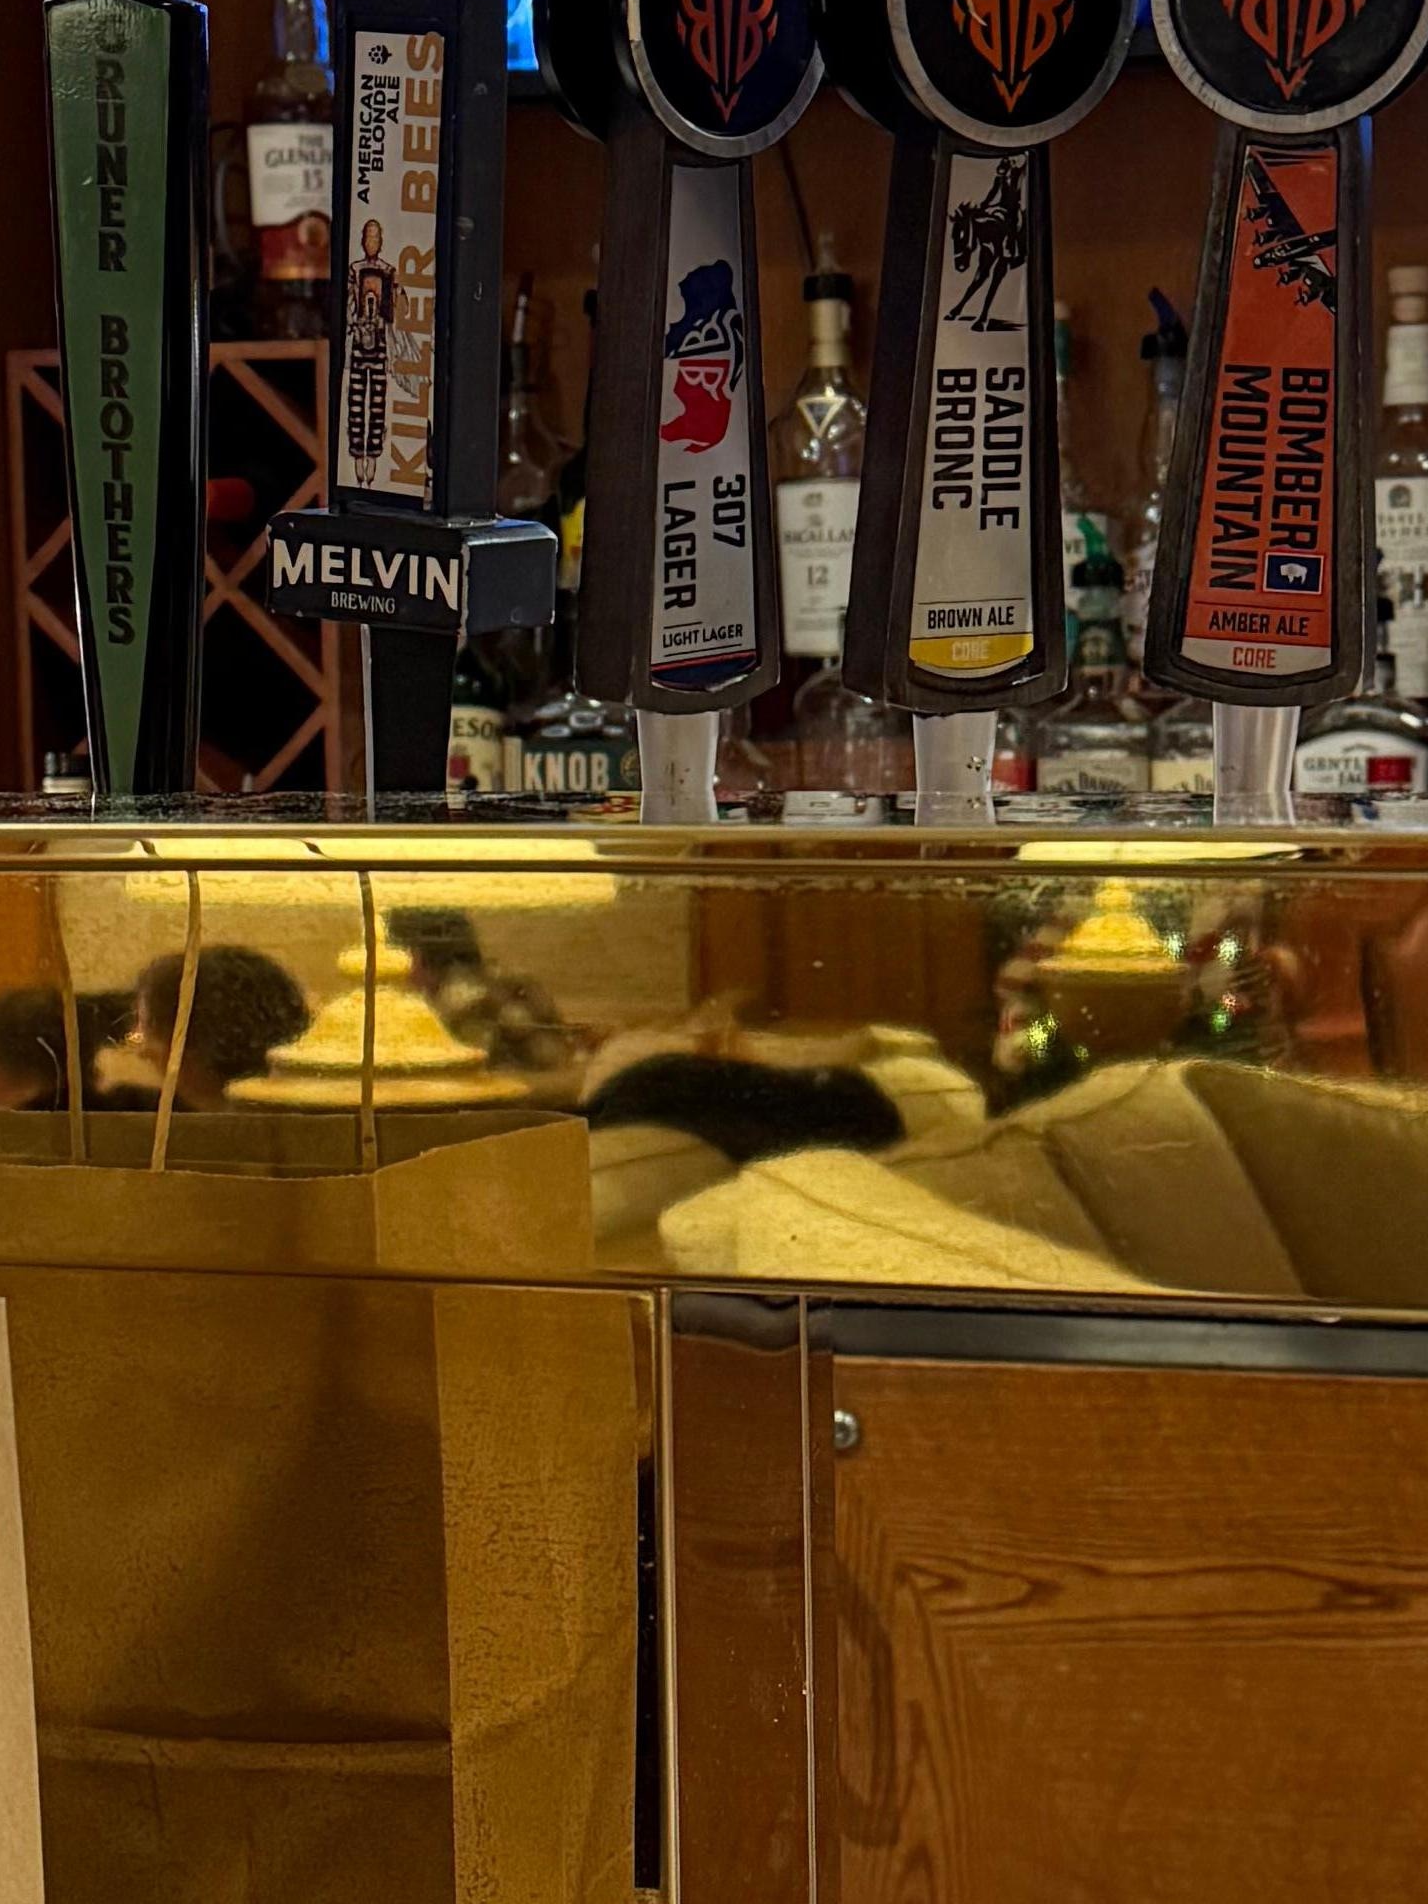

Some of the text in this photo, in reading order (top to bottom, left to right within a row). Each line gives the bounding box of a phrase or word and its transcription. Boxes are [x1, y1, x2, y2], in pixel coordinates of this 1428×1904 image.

[372, 74, 387, 173] BLONDE
[387, 75, 400, 124] ALE
[358, 73, 373, 205] AMERICAN
[388, 31, 444, 491] KILLER BEES
[932, 367, 977, 510] BRONC
[979, 367, 1025, 531] SADDLE
[1271, 367, 1330, 552] BOMBER
[98, 314, 135, 645] BROTHERS
[712, 473, 746, 547] 307
[1209, 363, 1272, 592] MOUNTAIN
[273, 539, 460, 610] MELVIN
[663, 480, 696, 611] LAGER
[806, 565, 829, 586] 12
[331, 591, 396, 615] BREWING
[662, 623, 743, 648] LIGHT LAGER
[927, 604, 1015, 631] BROWN ALE
[1208, 609, 1309, 637] AMBER ALE
[951, 638, 990, 662] CORE
[1232, 645, 1277, 669] CORE
[524, 751, 610, 791] KNOB
